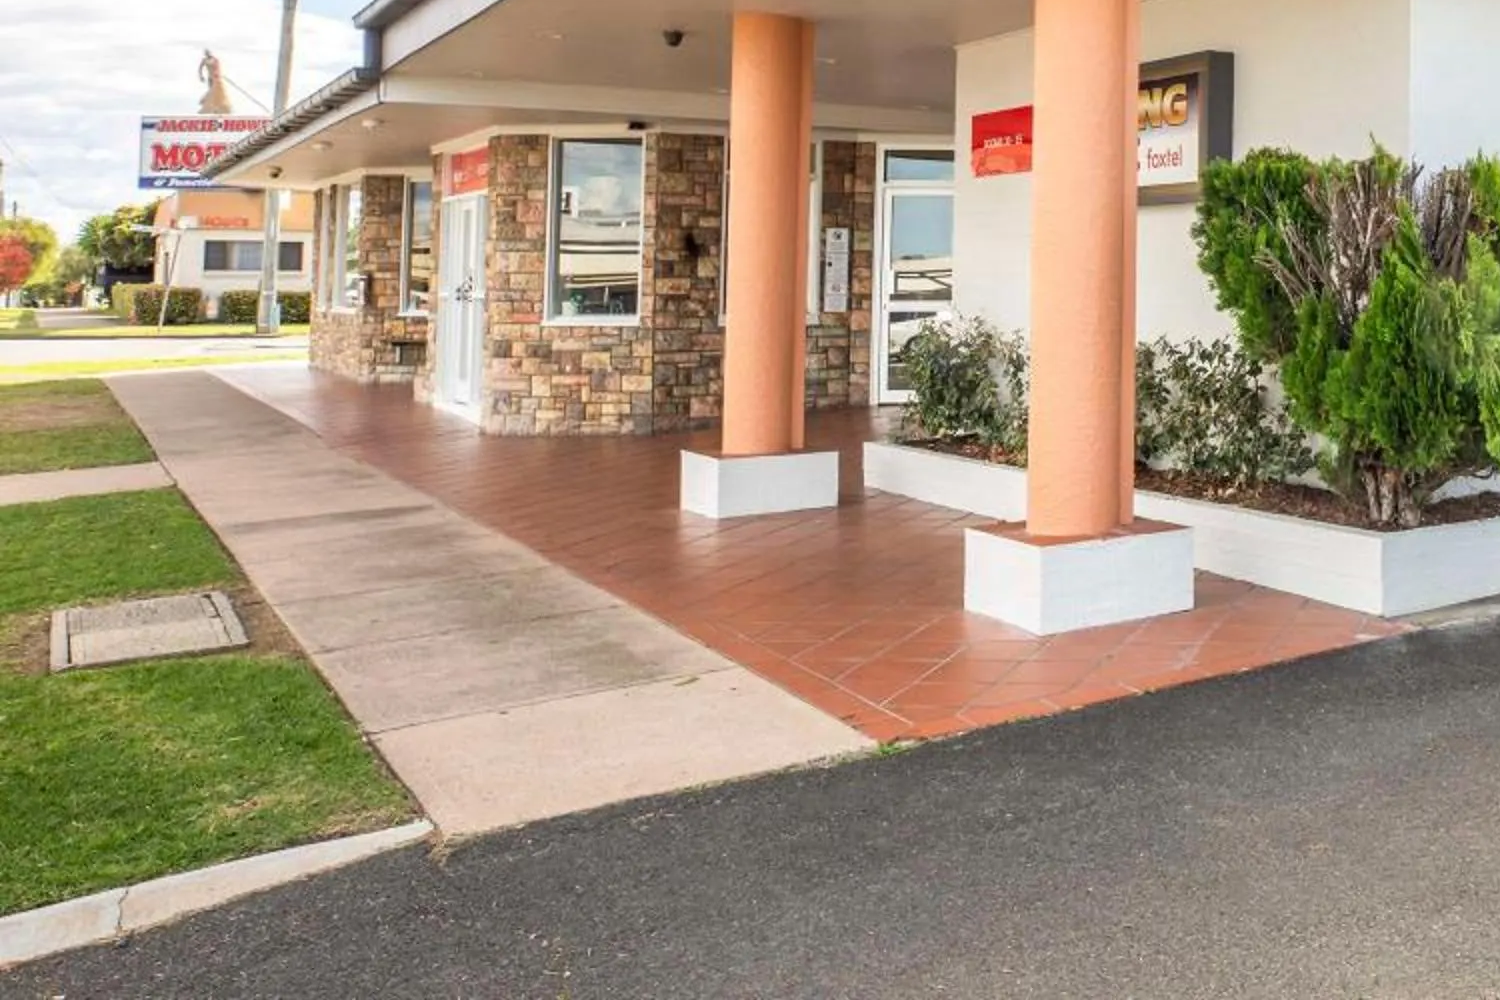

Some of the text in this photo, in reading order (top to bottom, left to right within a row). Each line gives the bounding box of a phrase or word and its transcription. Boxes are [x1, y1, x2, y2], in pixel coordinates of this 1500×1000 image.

[157, 119, 215, 132] JACKIE
[151, 142, 227, 172] MOT
[1147, 144, 1183, 170] foxtel
